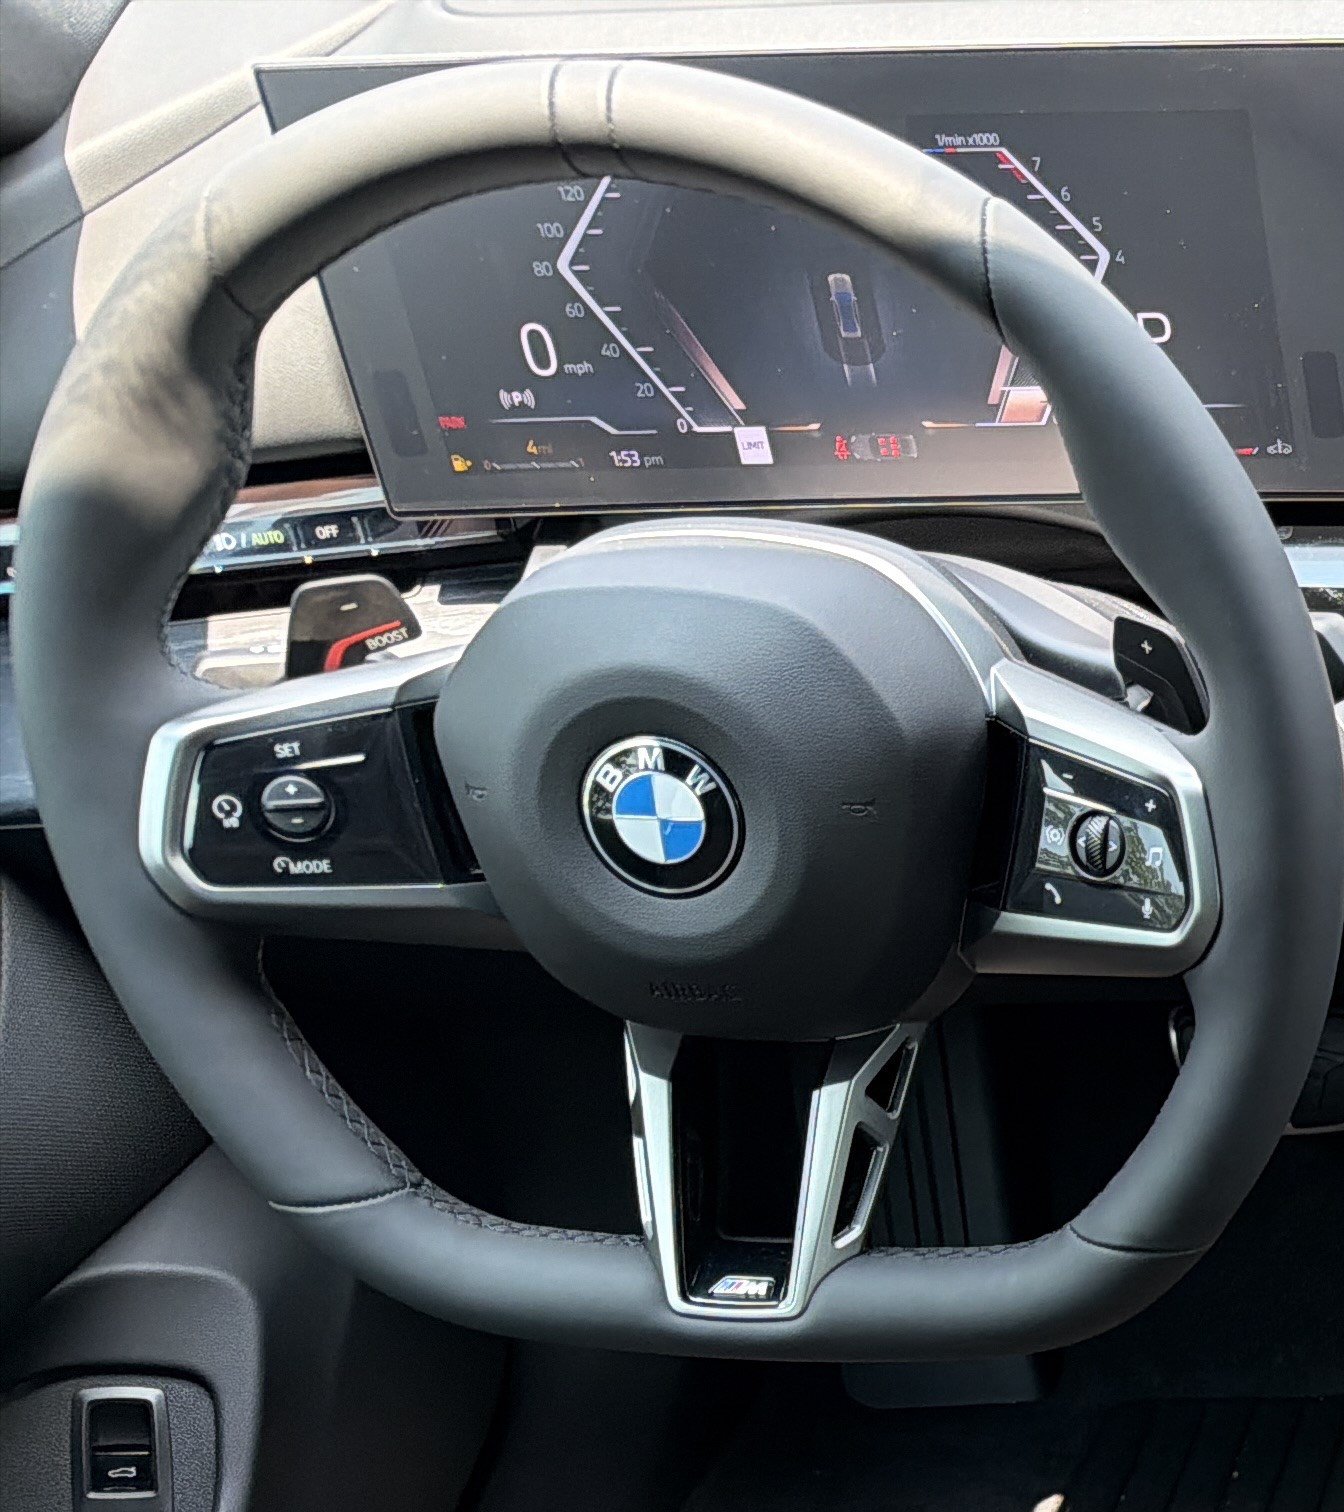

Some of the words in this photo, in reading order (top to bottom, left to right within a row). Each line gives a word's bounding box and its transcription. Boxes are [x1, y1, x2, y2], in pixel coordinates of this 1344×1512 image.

[966, 132, 1000, 146] x1000
[1031, 156, 1041, 172] 7
[556, 185, 585, 202] 120
[1060, 186, 1071, 202] 6
[536, 222, 565, 238] 100
[1092, 216, 1103, 232] 5
[1115, 249, 1126, 265] 4
[532, 261, 554, 277] 80
[565, 302, 585, 318] 60
[520, 322, 558, 377] 0
[563, 361, 594, 377] mph
[600, 342, 620, 358] 40
[634, 382, 655, 398] 20
[676, 418, 688, 434] 0
[609, 450, 641, 467] 1:53
[644, 454, 665, 469] pm
[251, 529, 285, 546] AUTO
[314, 524, 340, 540] OFF
[364, 627, 409, 651] BOOST
[273, 741, 301, 759] SET
[595, 747, 717, 796] BMW
[288, 859, 333, 875] MODE
